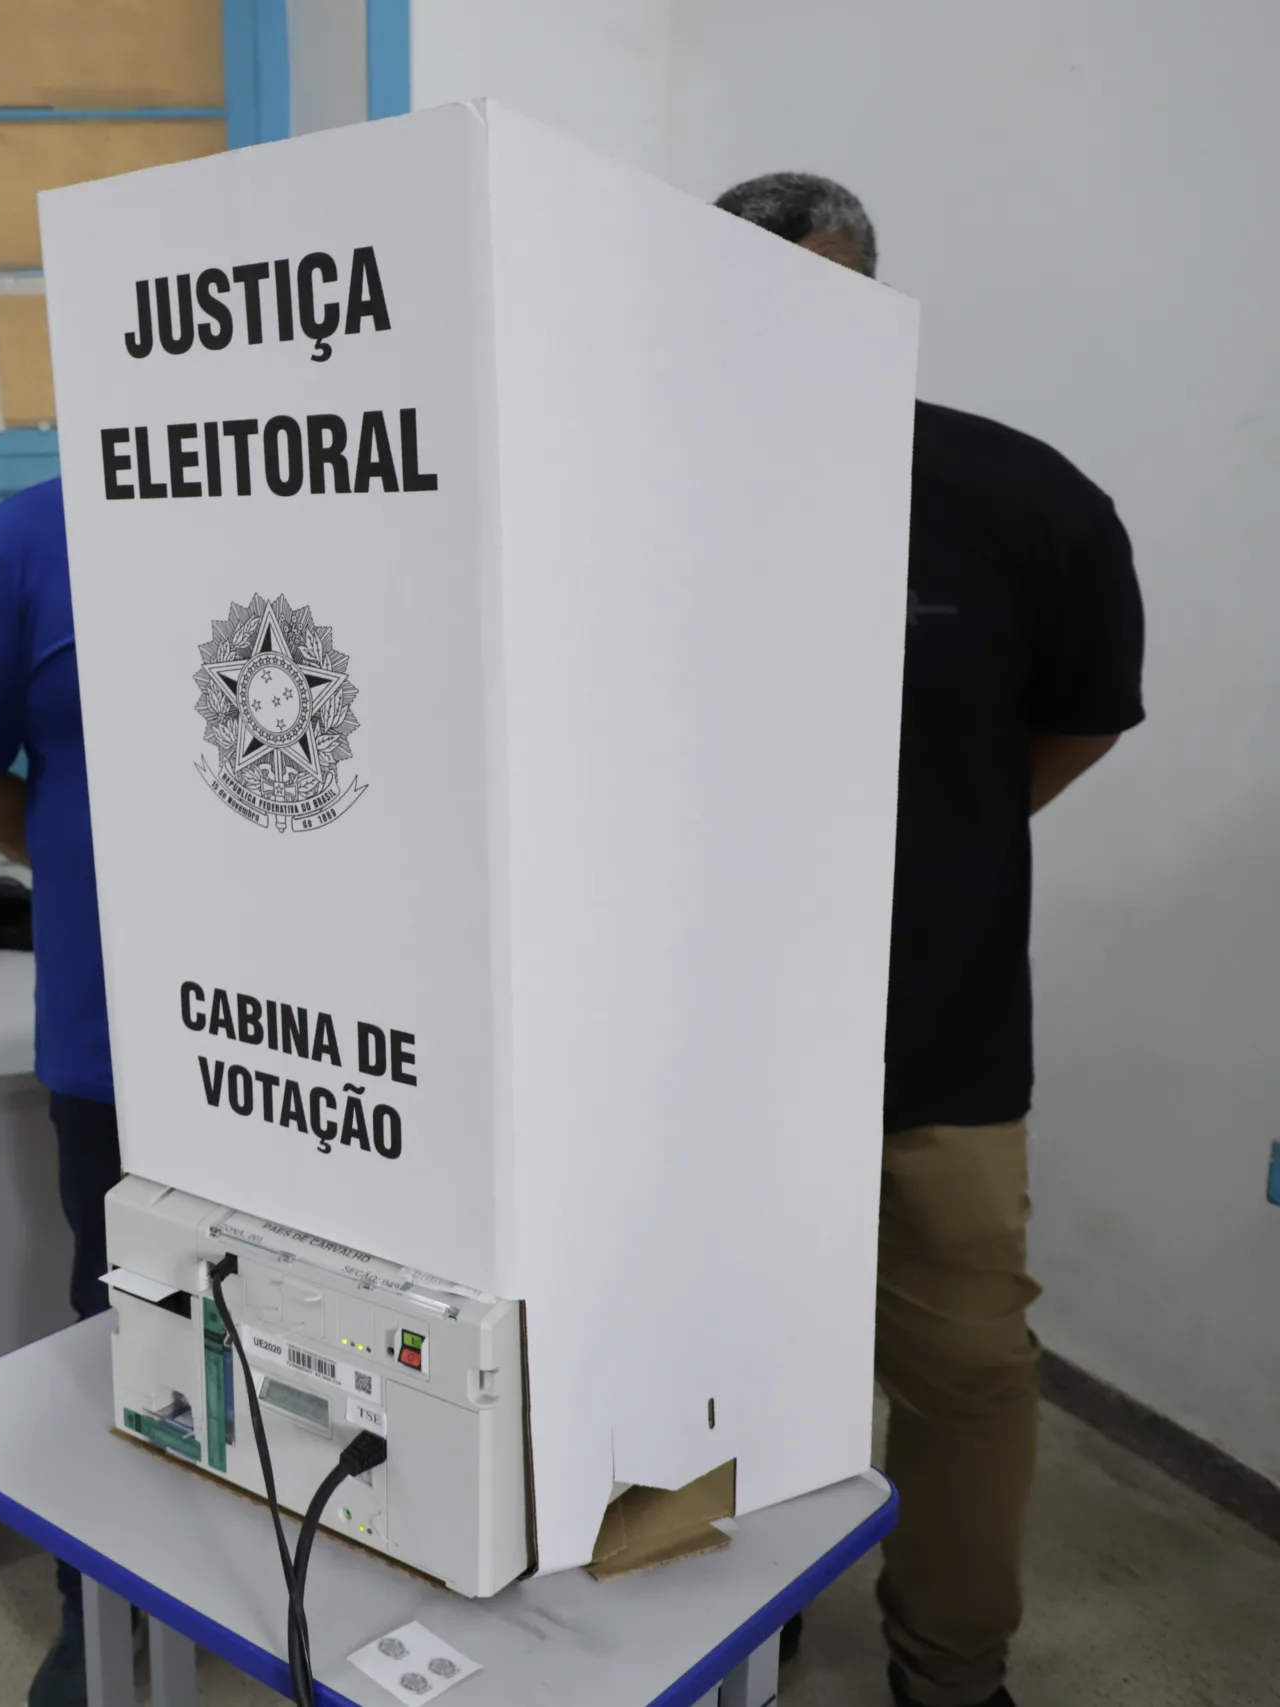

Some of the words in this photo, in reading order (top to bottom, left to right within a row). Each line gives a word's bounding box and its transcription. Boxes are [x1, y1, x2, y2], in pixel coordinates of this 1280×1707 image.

[125, 246, 392, 363] JUSTIÇA
[101, 407, 439, 500] ELEITORAL
[211, 780, 219, 790] 15
[227, 796, 260, 822] Novembro
[318, 808, 337, 824] 1889
[258, 799, 299, 814] FEDERATIVA
[300, 801, 311, 812] DO
[312, 788, 337, 809] BRASIL
[180, 981, 342, 1068] CABINA
[357, 1021, 418, 1087] DE
[197, 1055, 402, 1160] VOTAÇÃO
[262, 1222, 292, 1237] PAES
[292, 1232, 309, 1243] DE
[309, 1235, 371, 1263] CARVALHO
[253, 1336, 282, 1355] UE2020
[357, 1406, 382, 1425] TSE
